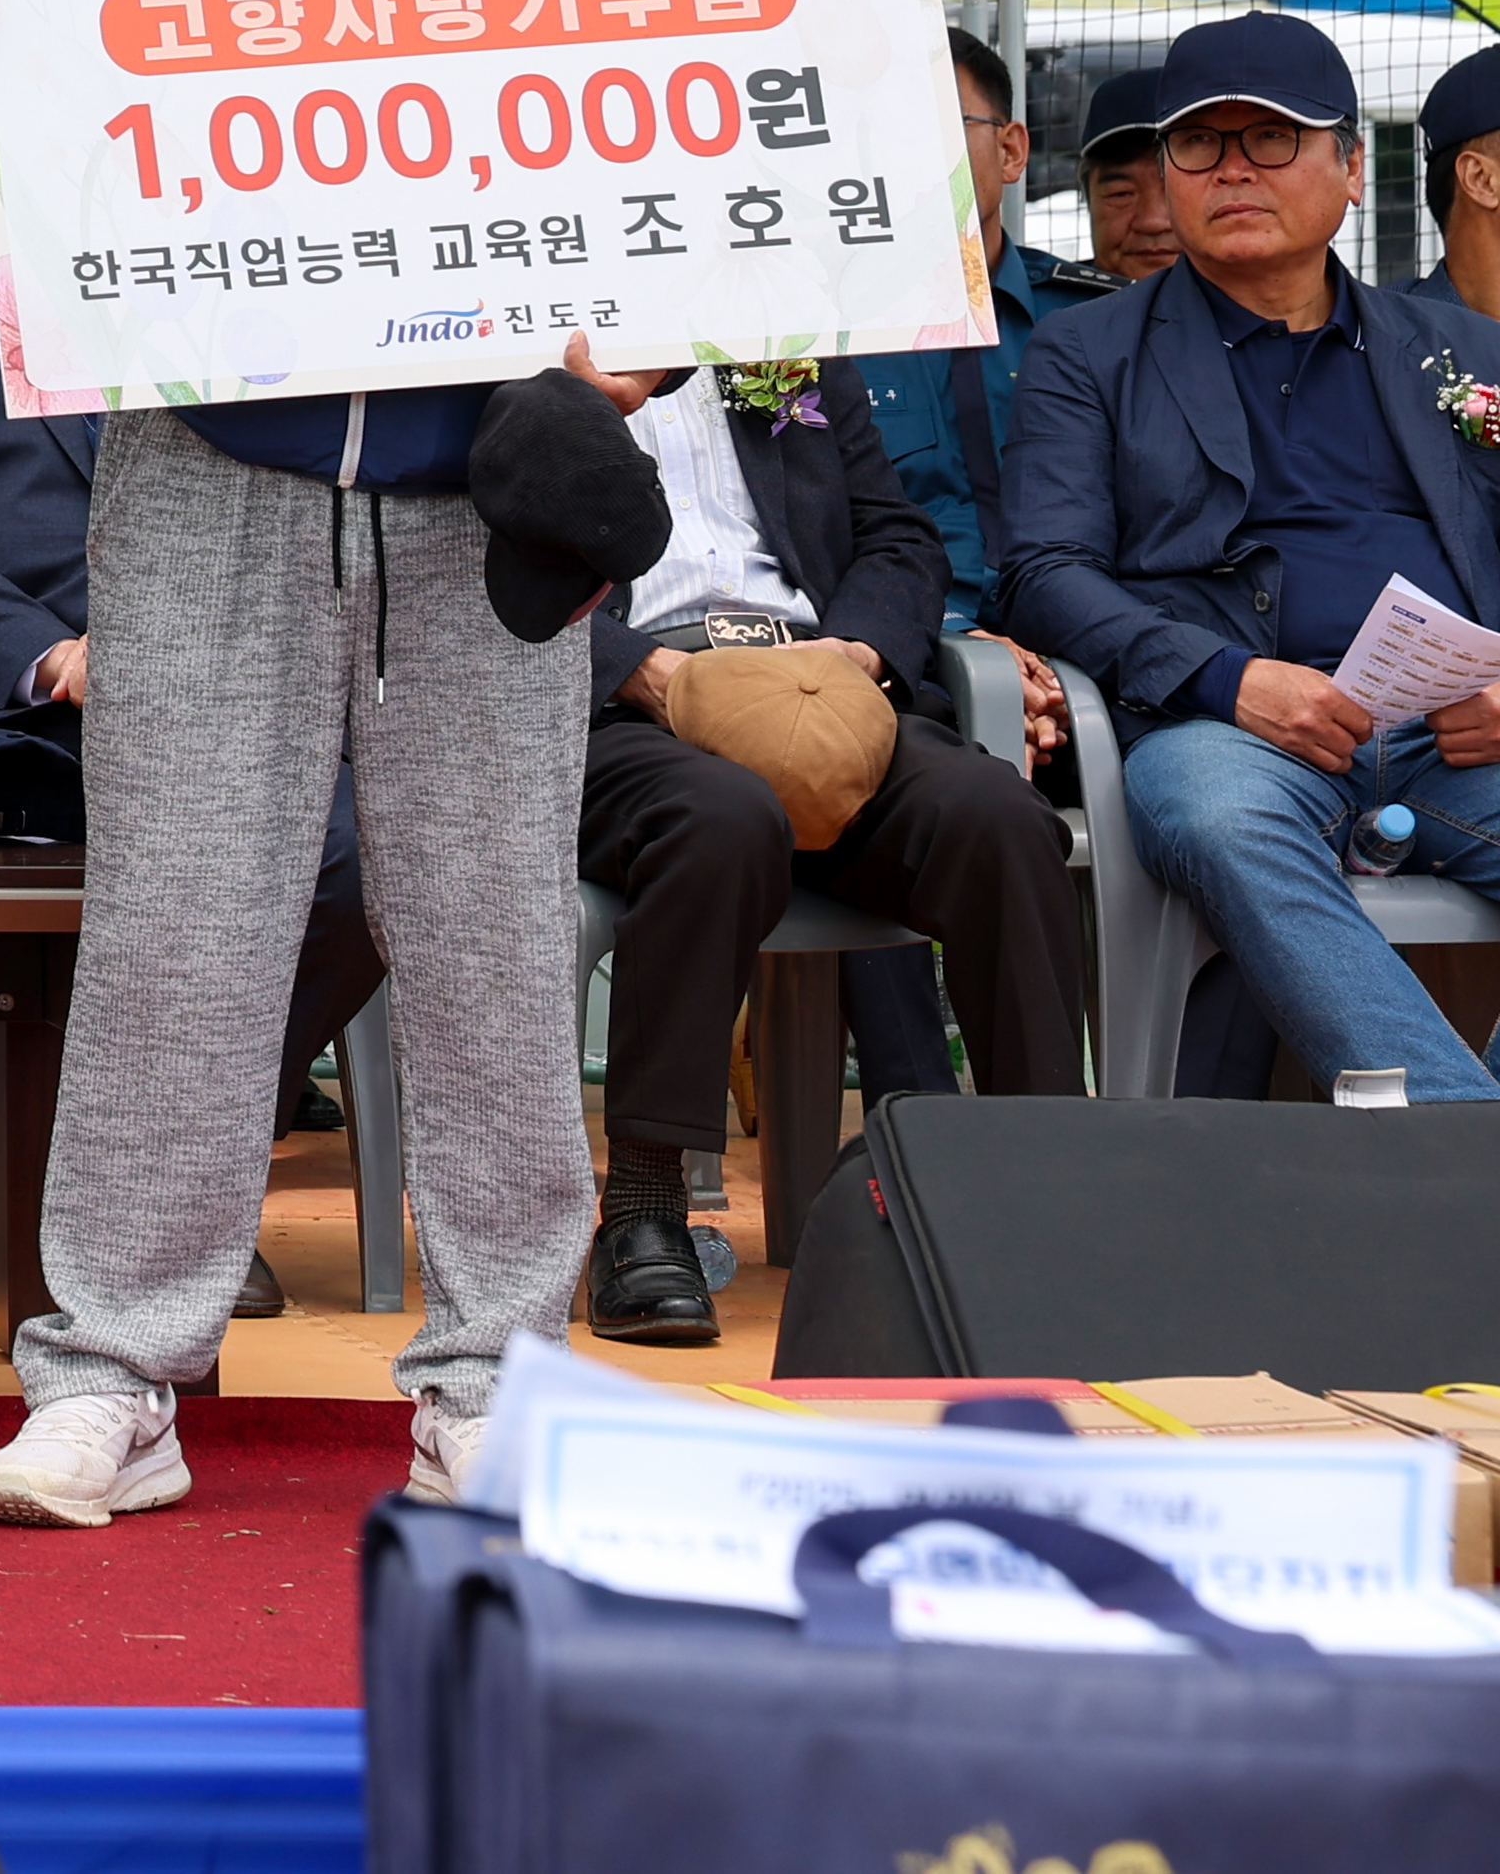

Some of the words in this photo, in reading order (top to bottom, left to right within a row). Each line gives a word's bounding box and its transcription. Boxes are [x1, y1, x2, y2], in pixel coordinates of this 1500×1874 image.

[104, 62, 831, 214] 1,000,000원
[72, 229, 399, 300] 한국직업능력
[430, 215, 588, 270] 교육원
